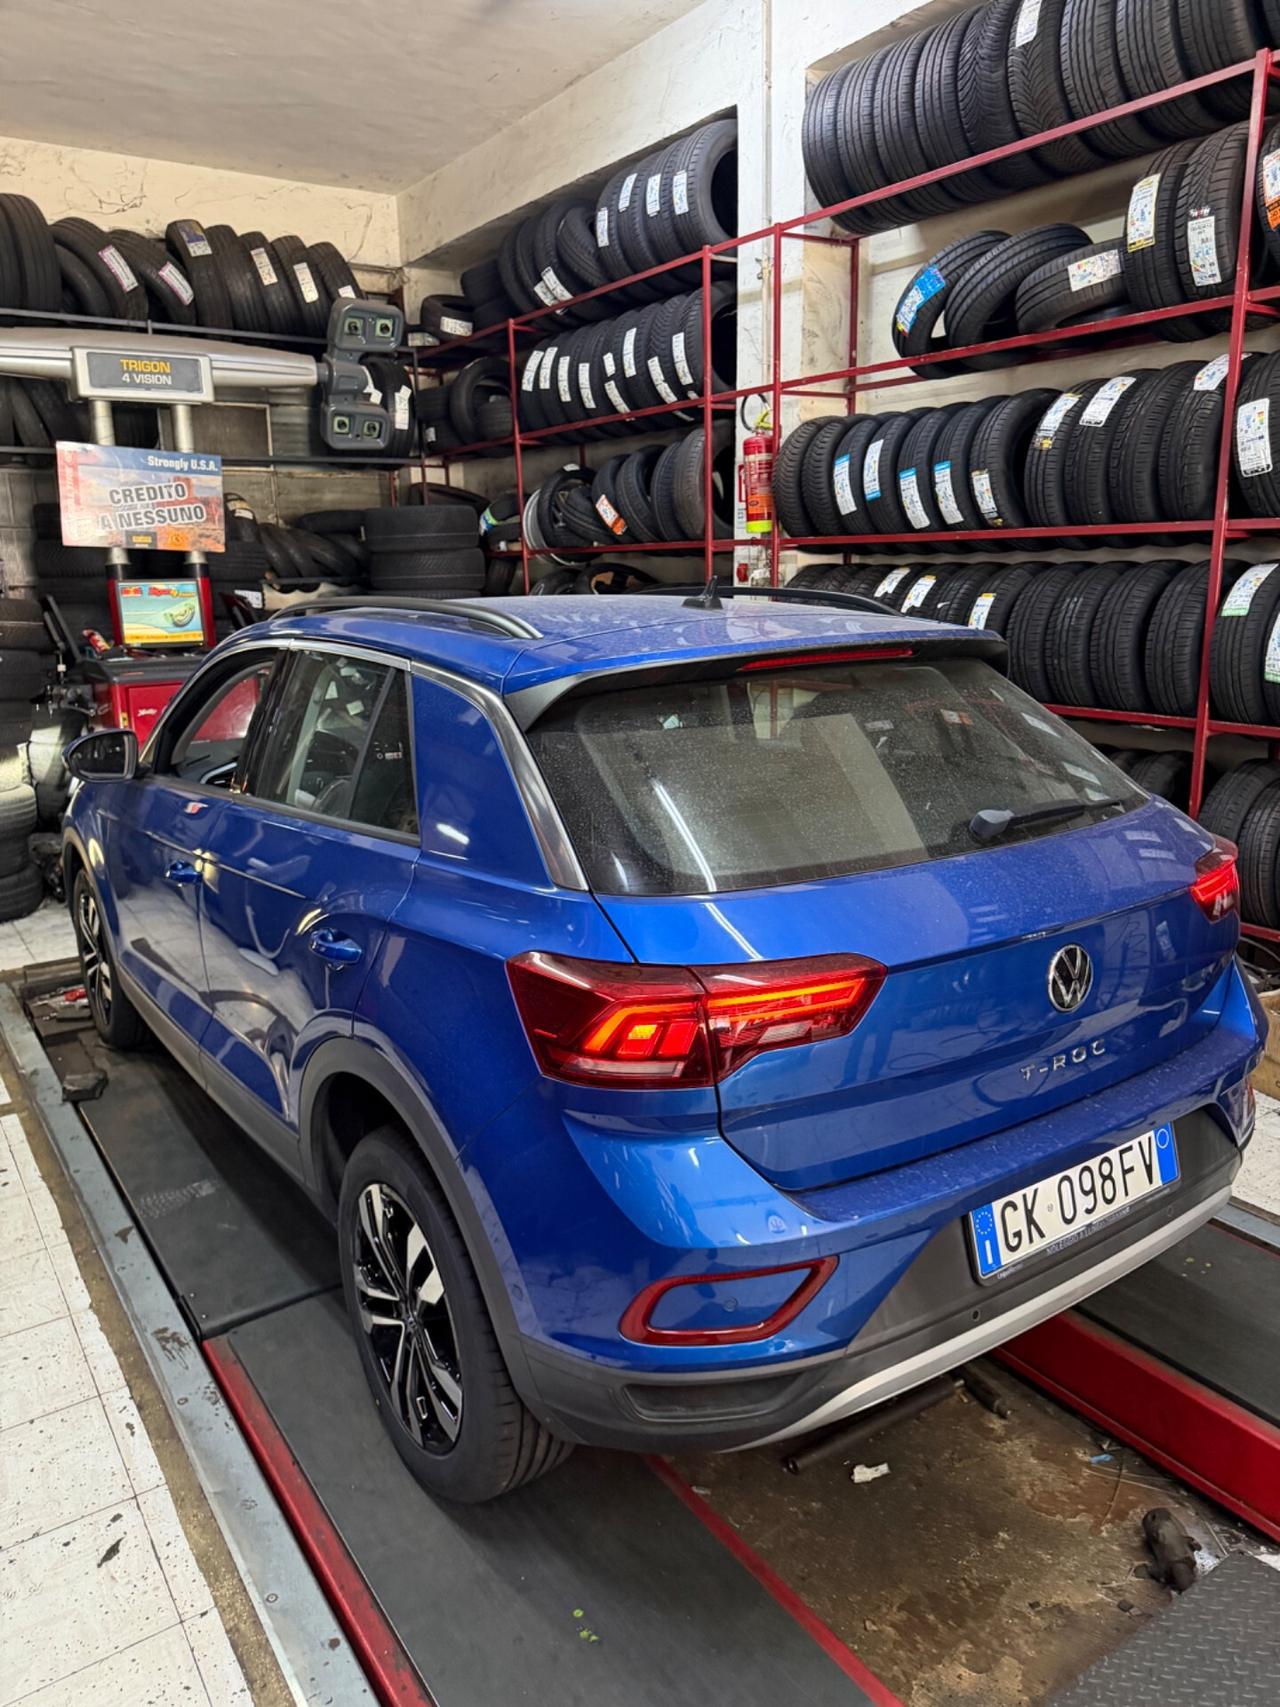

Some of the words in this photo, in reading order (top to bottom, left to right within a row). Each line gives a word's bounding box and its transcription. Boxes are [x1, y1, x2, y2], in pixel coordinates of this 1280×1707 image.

[120, 358, 172, 374] TRIGON
[122, 373, 131, 383] 4
[133, 374, 172, 386] VISION
[147, 455, 190, 471] Strongly
[190, 460, 219, 472] U.S.A.
[109, 482, 187, 506] CREDITO
[100, 514, 114, 531] A
[118, 504, 206, 529] NESSUNO
[1020, 1039, 1107, 1082] T-ROC
[1000, 1187, 1046, 1253] GK
[1057, 1135, 1154, 1225] 098FV
